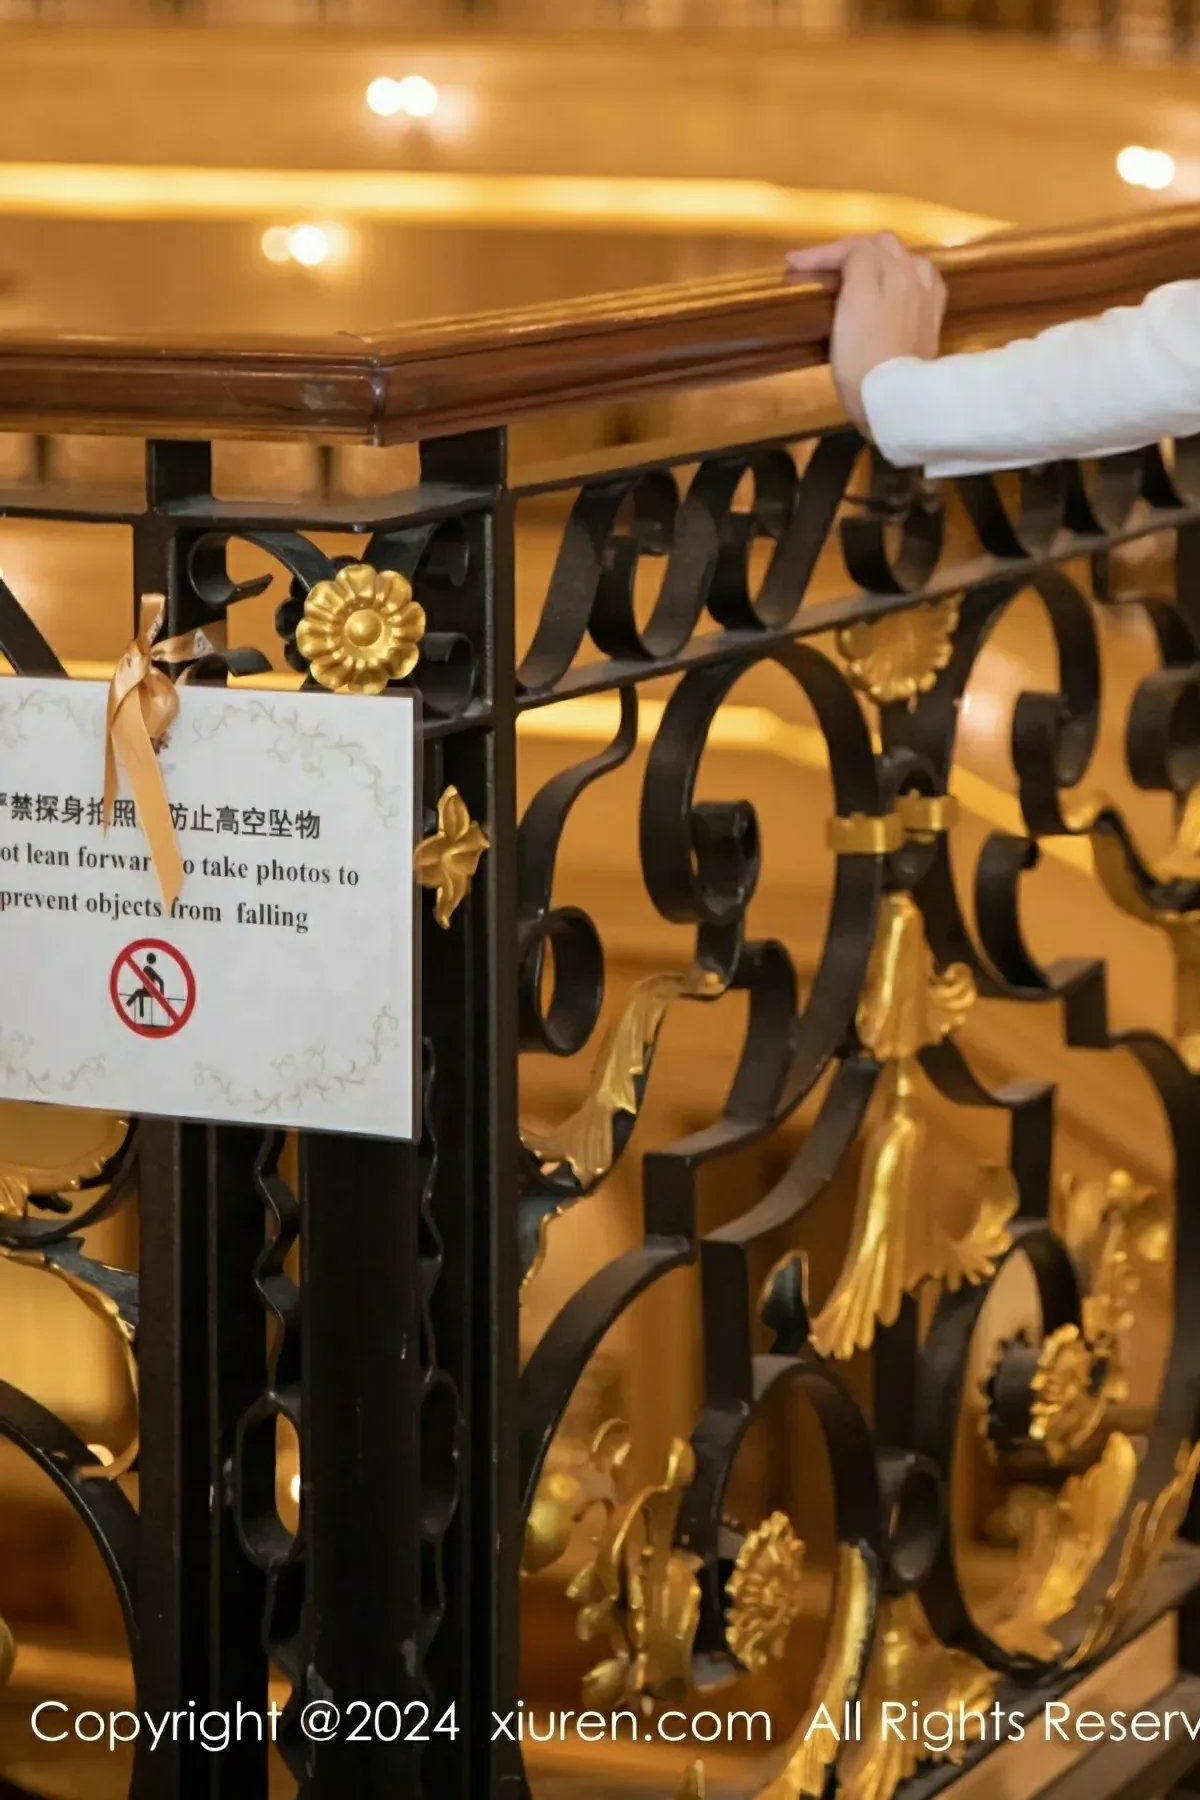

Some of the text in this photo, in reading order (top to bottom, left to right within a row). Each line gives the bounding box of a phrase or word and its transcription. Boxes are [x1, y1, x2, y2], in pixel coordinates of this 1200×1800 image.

[0, 843, 19, 863] ot
[27, 842, 69, 867] lean
[78, 846, 153, 872] forwar
[202, 855, 249, 879] take
[256, 859, 331, 886] photos
[338, 865, 360, 886] to
[0, 890, 309, 934] prevent objects from falling
